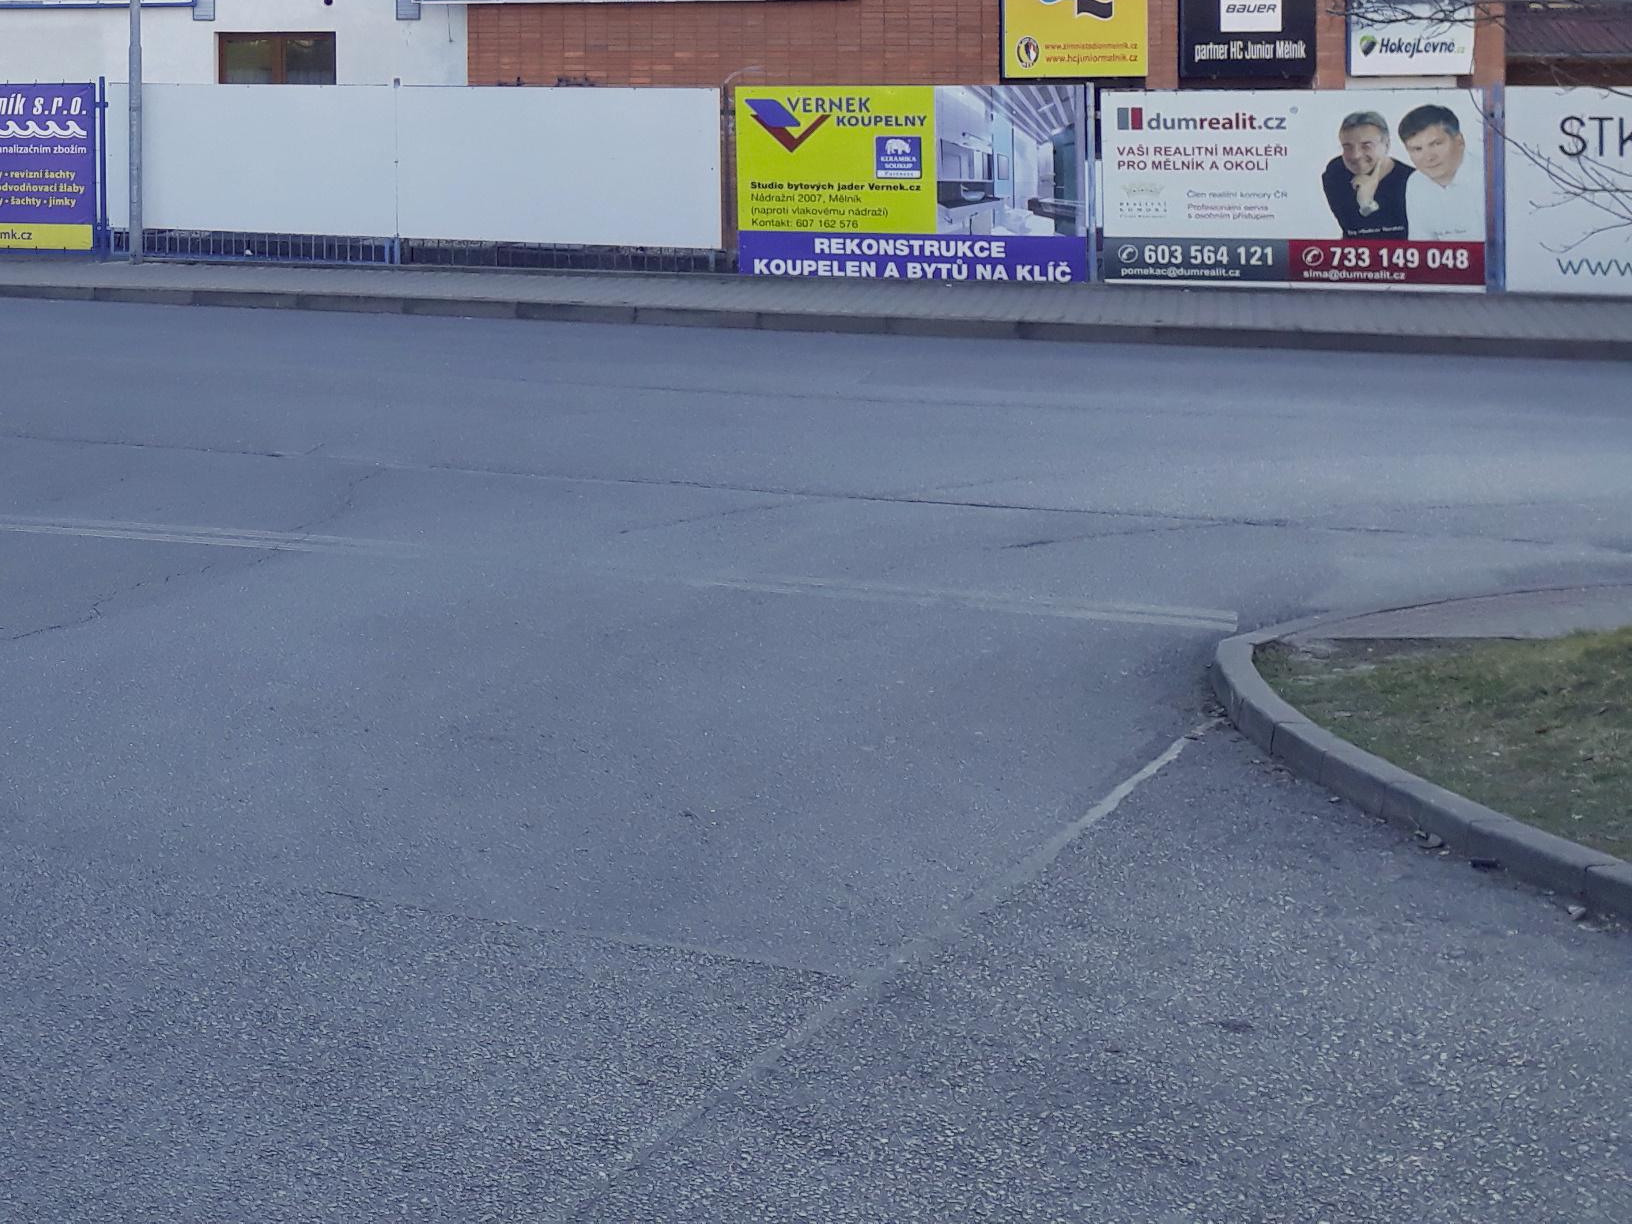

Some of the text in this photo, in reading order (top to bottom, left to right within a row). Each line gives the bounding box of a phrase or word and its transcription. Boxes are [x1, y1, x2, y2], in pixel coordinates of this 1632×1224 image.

[1194, 39, 1306, 61] partner HC Junior Mělník
[32, 96, 87, 116] s.r.o.
[787, 96, 871, 114] VERNEK
[836, 115, 927, 127] KOUPELNY
[1147, 110, 1288, 131] dumrealit.cz
[53, 144, 87, 155] zbožím
[1117, 144, 1288, 157] VAŠI REALITNÍ MAKLÉŘI
[1117, 158, 1269, 171] PRO MĚLNÍK A OKOLÍ
[10, 169, 76, 180] revizní šachty
[750, 181, 921, 193] Studio bytových jader Vernek.cz
[10, 195, 42, 207] šachty
[48, 196, 76, 208] jímky
[750, 192, 863, 204] Nádražní 2007, Mělník
[750, 205, 889, 218] (naproti vlakovému nádraží)
[751, 217, 859, 229] Kontakt: 607 162 576
[814, 237, 1006, 258] REKONSTRUKCE
[1143, 246, 1274, 266] 603 564 121
[1330, 247, 1469, 269] 733 149 048
[753, 258, 1072, 282] KOUPELEN A BYTŮ NA KLÍČ
